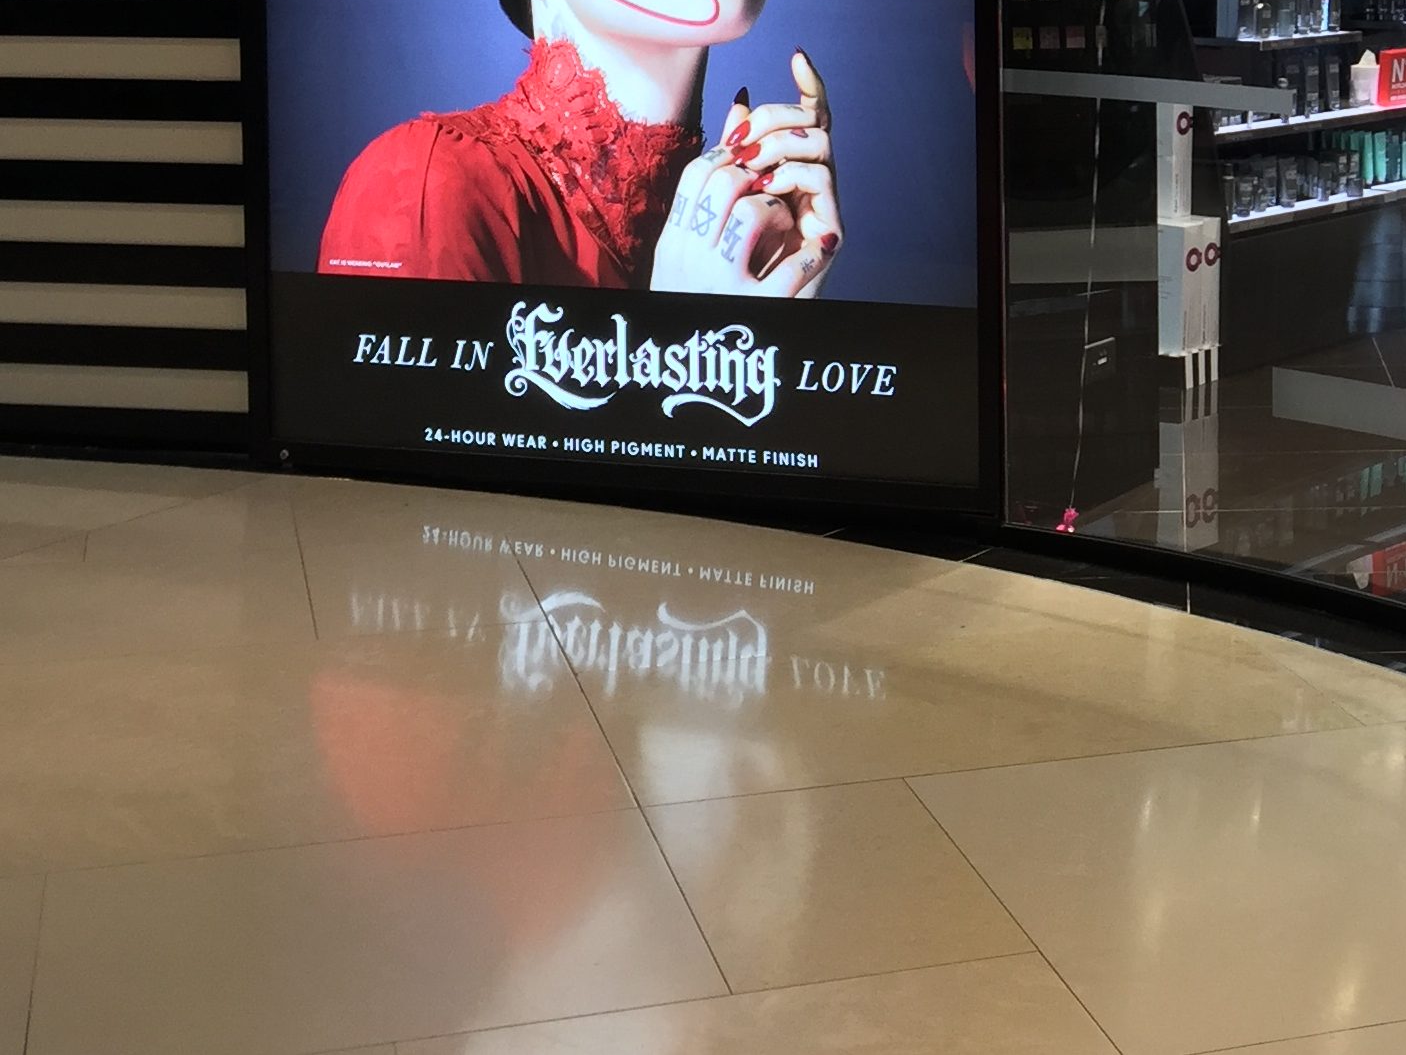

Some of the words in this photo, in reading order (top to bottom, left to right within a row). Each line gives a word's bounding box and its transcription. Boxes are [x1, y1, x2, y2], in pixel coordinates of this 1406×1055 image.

[353, 333, 438, 369] FALL
[451, 340, 495, 372] IN
[505, 300, 781, 427] Everlasting
[797, 360, 898, 397] LOVE
[424, 427, 497, 447] 24-HOUR
[502, 433, 548, 450] WEAR
[563, 438, 605, 454] HIGH
[610, 441, 686, 459] PIGMENT
[702, 447, 757, 464] MATTE
[763, 450, 819, 468] FINISH
